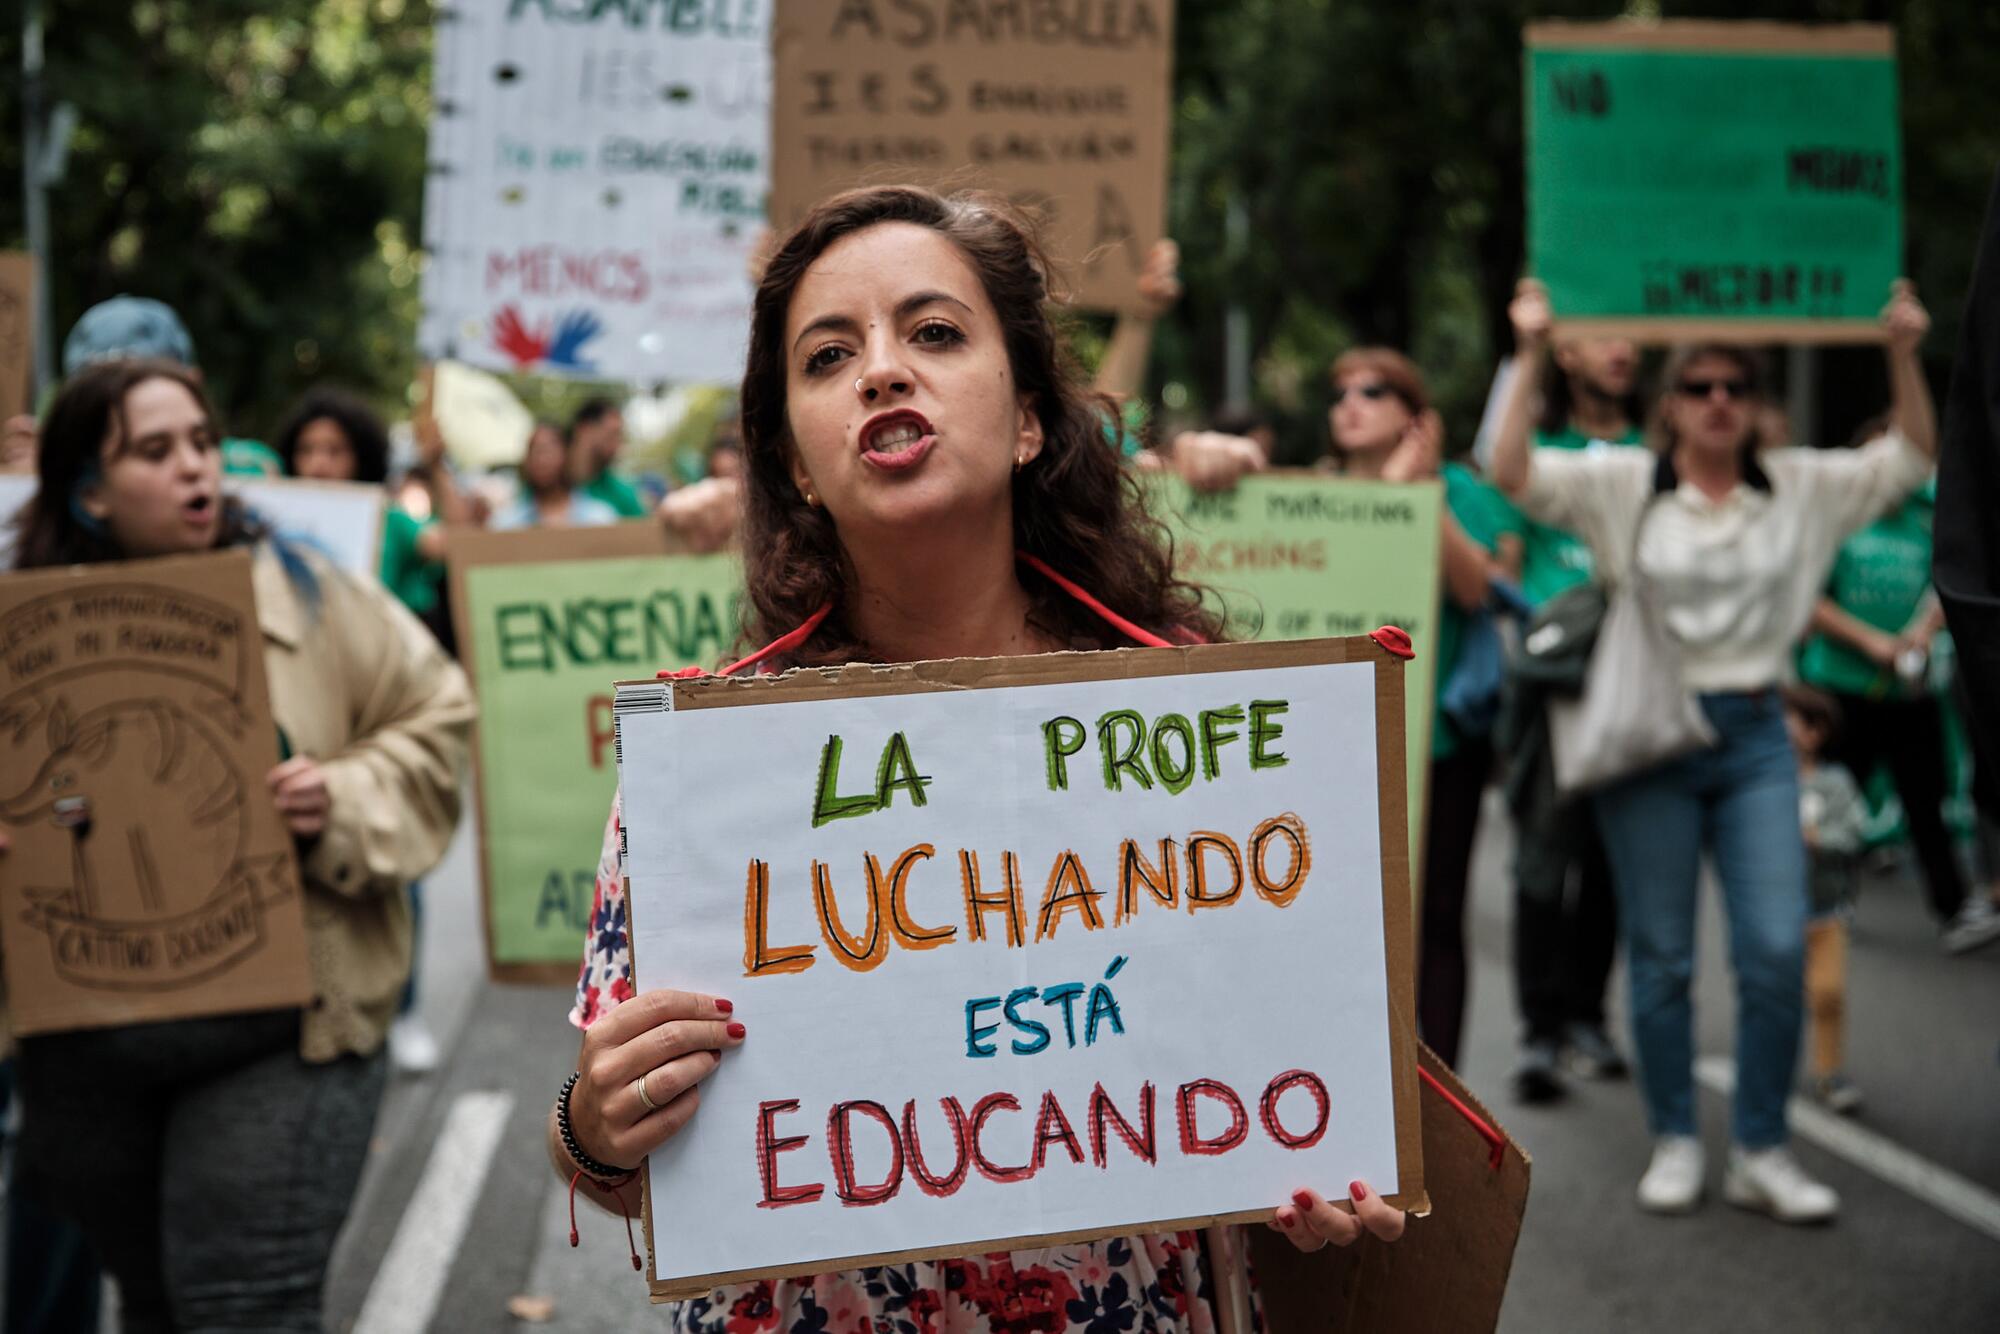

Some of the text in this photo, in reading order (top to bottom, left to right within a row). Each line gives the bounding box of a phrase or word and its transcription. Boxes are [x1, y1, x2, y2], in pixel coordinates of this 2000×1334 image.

[495, 589, 742, 674] ENSEÑA
[812, 699, 1289, 827] LA PROFE
[742, 811, 1312, 978] LUCHANDO
[964, 955, 1129, 1058] ESTÁ
[755, 1068, 1330, 1209] EDUCANDO
